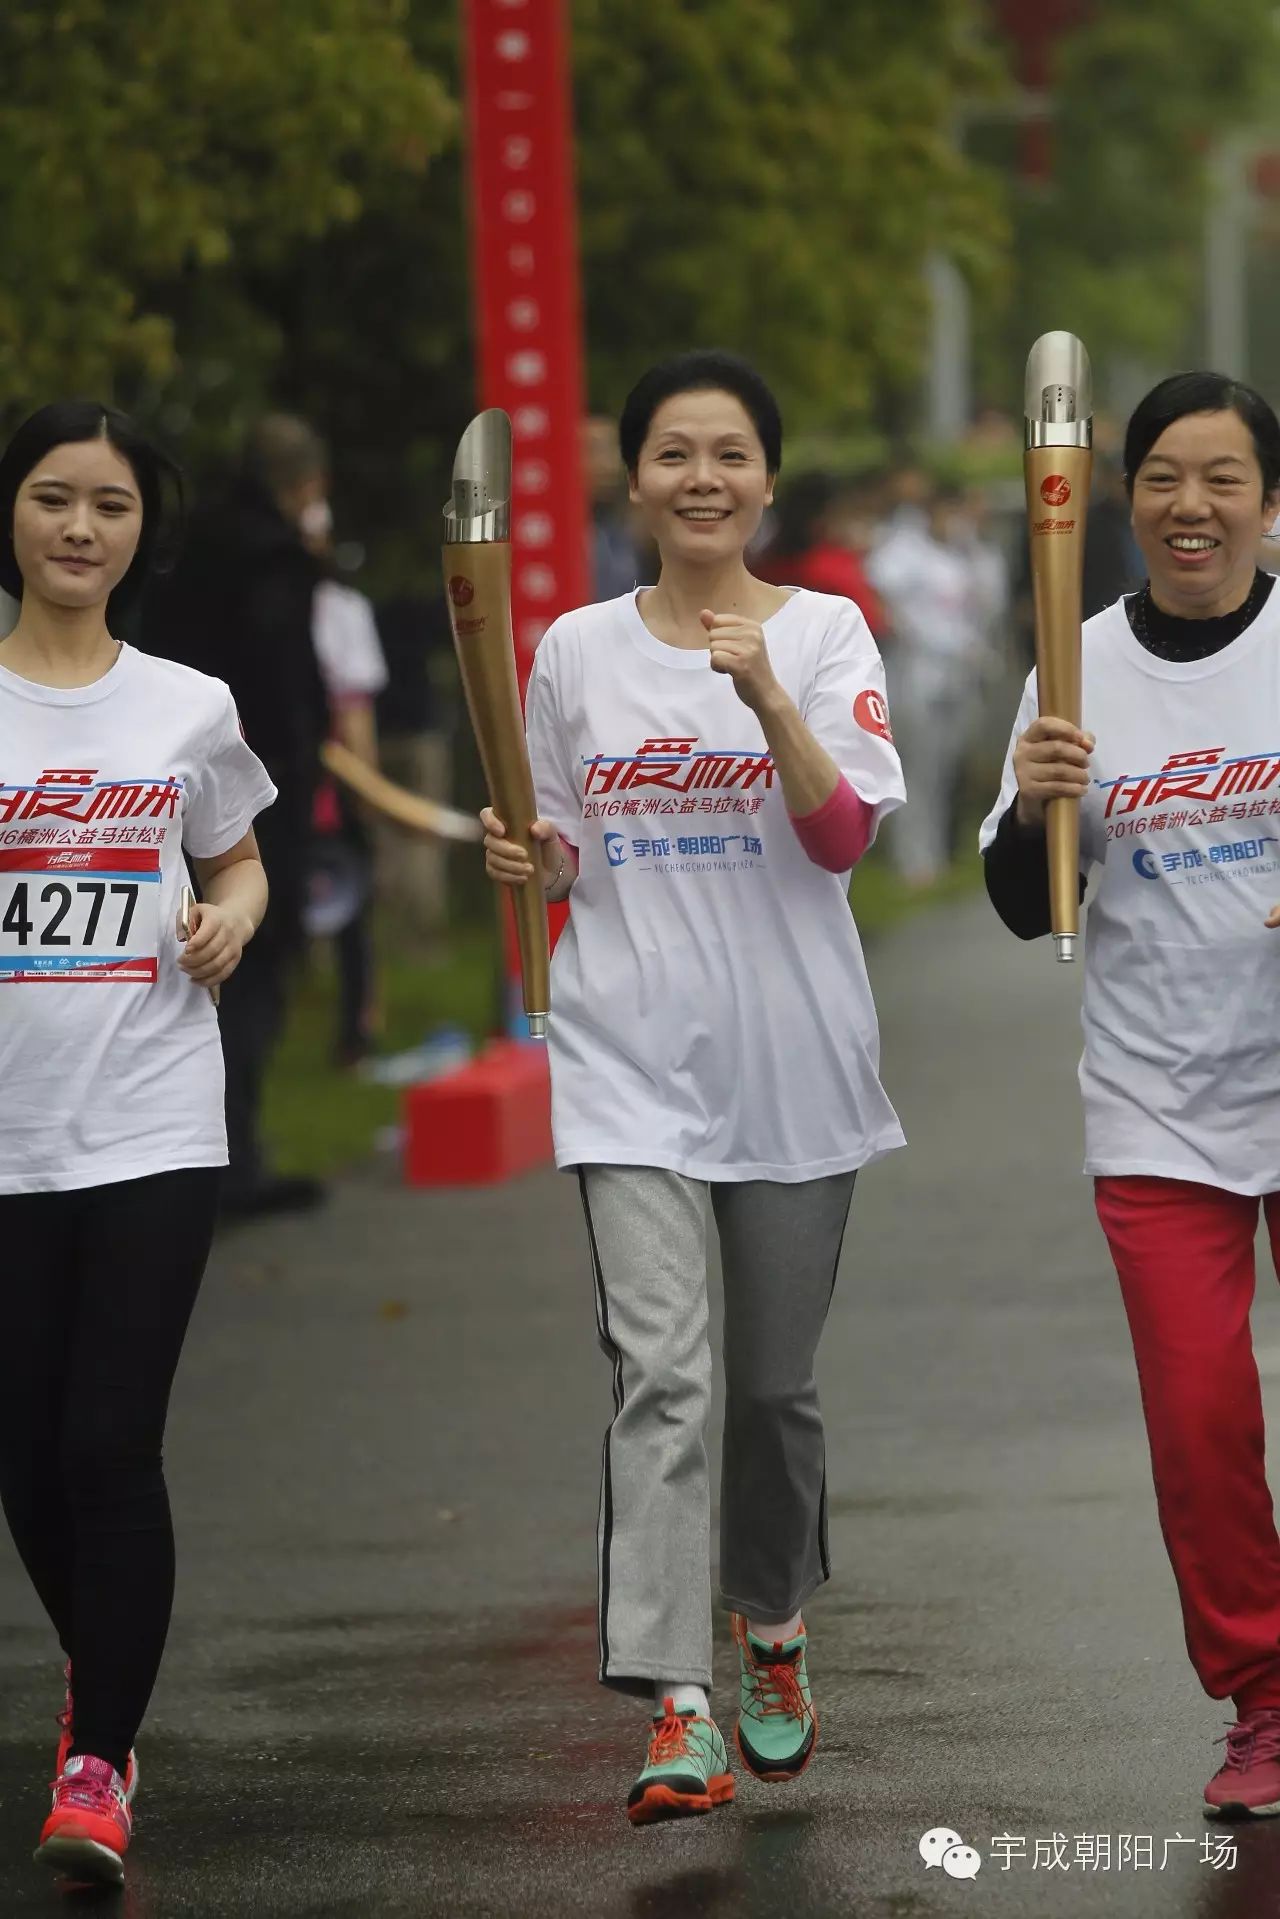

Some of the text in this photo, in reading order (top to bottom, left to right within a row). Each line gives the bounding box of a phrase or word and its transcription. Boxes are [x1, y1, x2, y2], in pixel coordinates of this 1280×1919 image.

[584, 796, 766, 819] 2016橘洲公益马拉松赛
[1, 881, 139, 947] 4277
